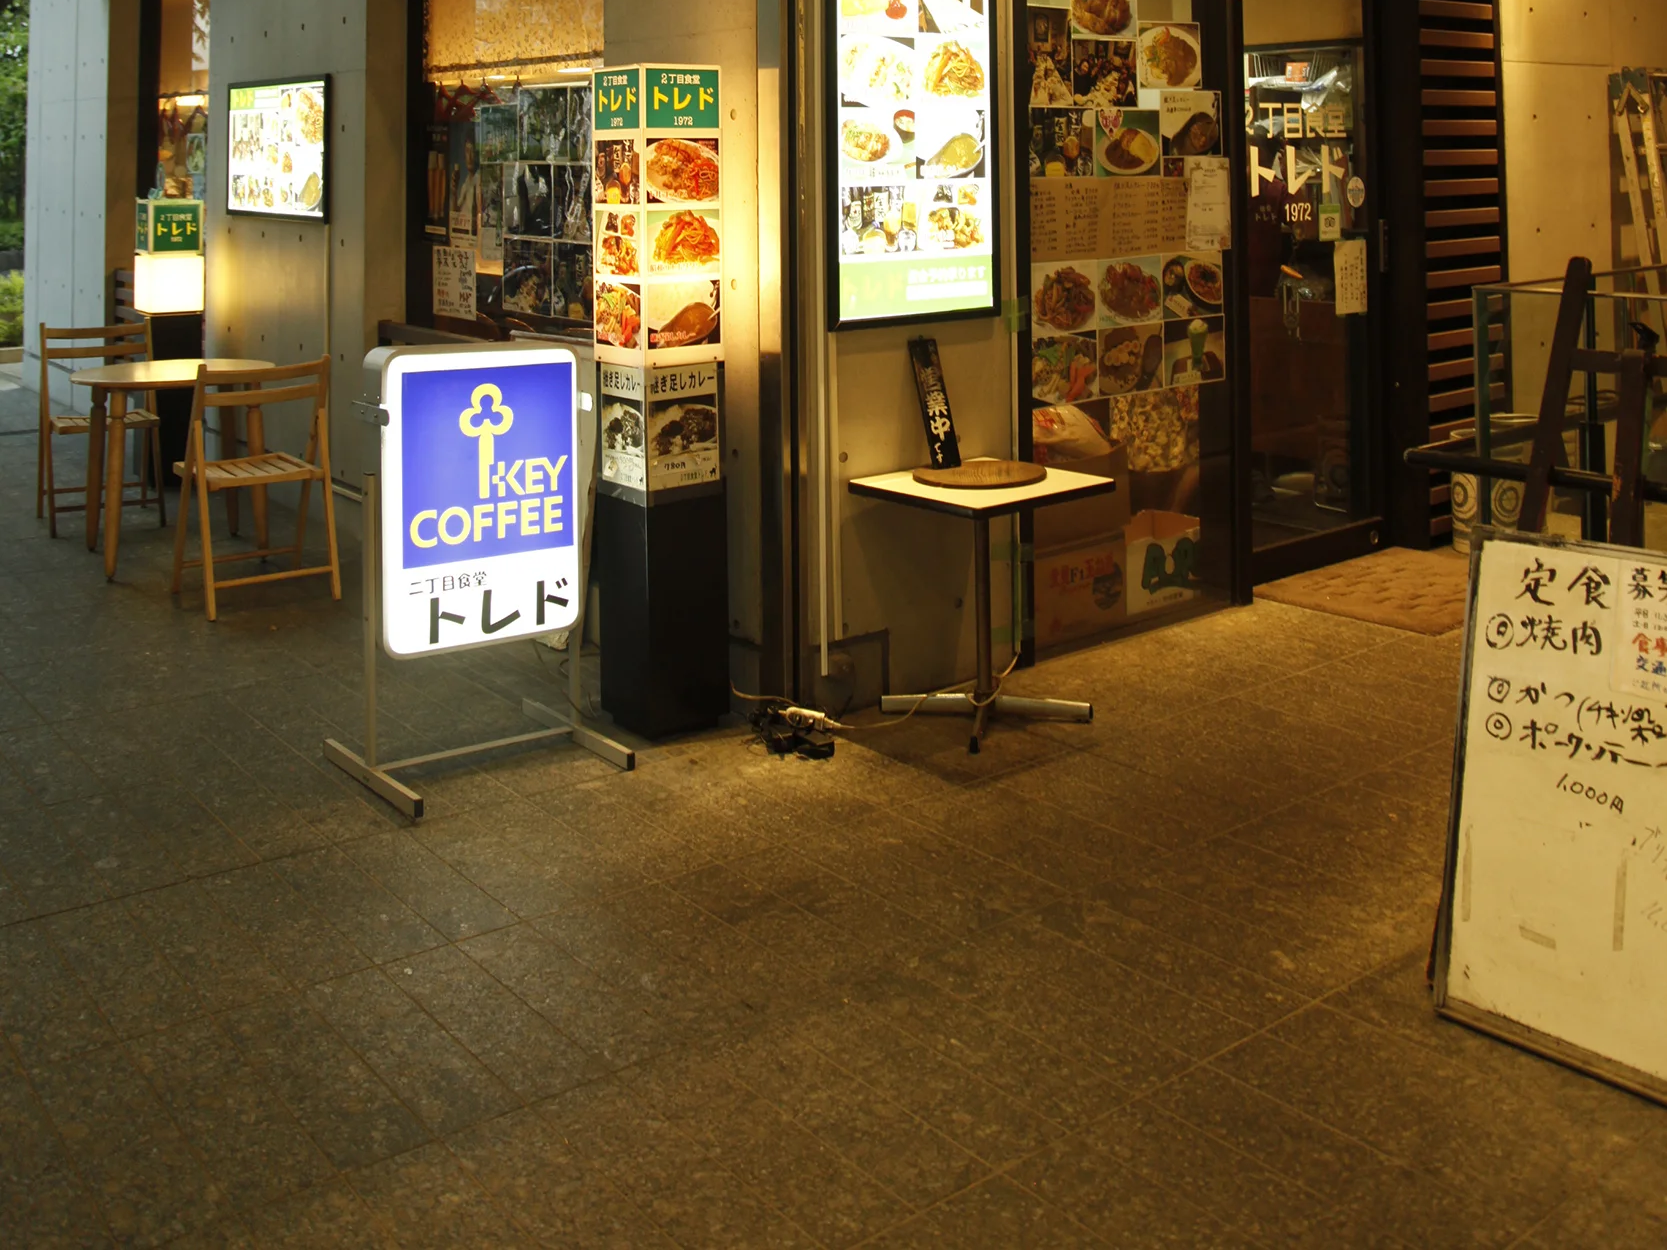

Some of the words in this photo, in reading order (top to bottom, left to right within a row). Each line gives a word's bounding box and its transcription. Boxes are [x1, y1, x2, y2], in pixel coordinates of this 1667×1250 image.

[661, 73, 700, 84] 2丁目食堂
[598, 87, 637, 112] トレド
[653, 86, 714, 110] トレド
[610, 117, 623, 127] 1972
[674, 116, 693, 126] 1972
[1249, 144, 1346, 198] トレド
[1284, 202, 1312, 223] 1972
[157, 222, 197, 236] トレド
[490, 454, 568, 497] KEY
[409, 496, 565, 549] COFFEE
[408, 570, 488, 596] 二丁目食堂
[1515, 557, 1611, 609] 定食
[428, 577, 570, 645] トレド
[1516, 614, 1602, 656] 焼肉
